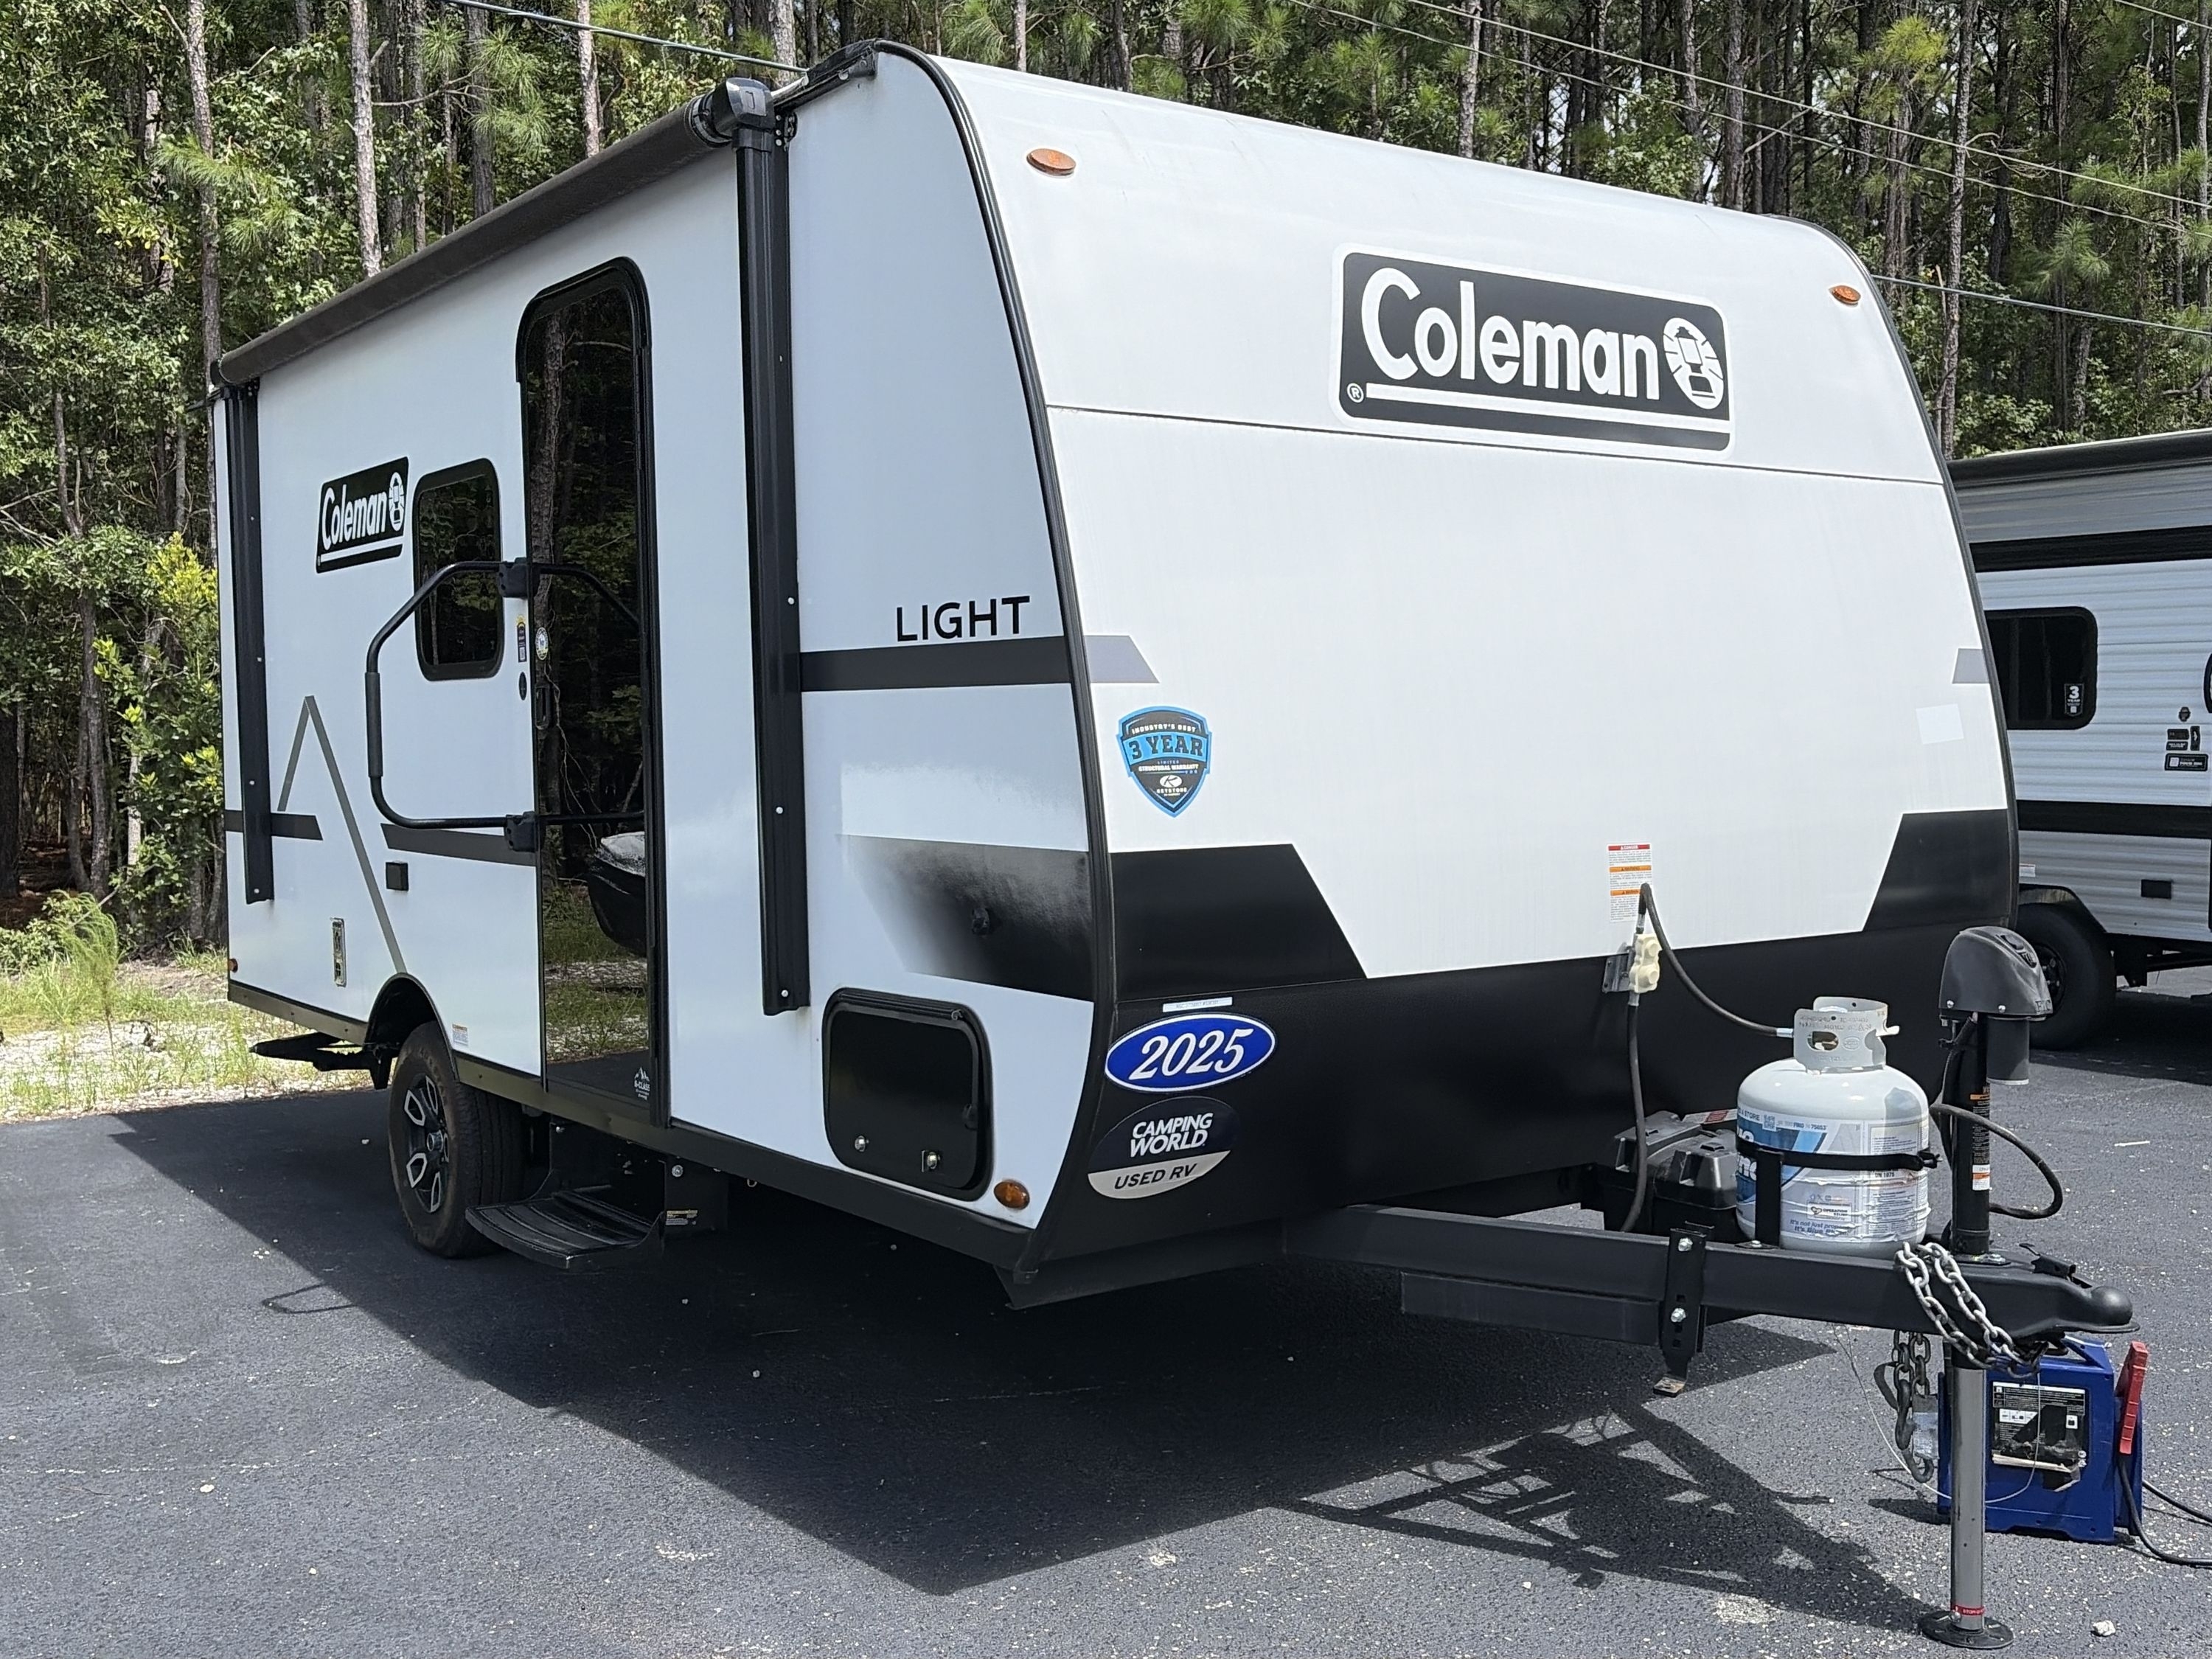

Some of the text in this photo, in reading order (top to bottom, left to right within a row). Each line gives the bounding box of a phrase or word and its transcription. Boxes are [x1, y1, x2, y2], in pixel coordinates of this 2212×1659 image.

[1361, 267, 1660, 400] Coleman
[321, 484, 388, 551] Coleman
[897, 595, 1030, 642] LIGHT
[1129, 734, 1203, 759] 3 YEAR
[1128, 1029, 1254, 1080] 2025
[1133, 1113, 1214, 1138] CAMPING
[1745, 1110, 1760, 1121] STORE
[1130, 1129, 1208, 1158] WORLD
[1114, 1163, 1197, 1190] USED RV
